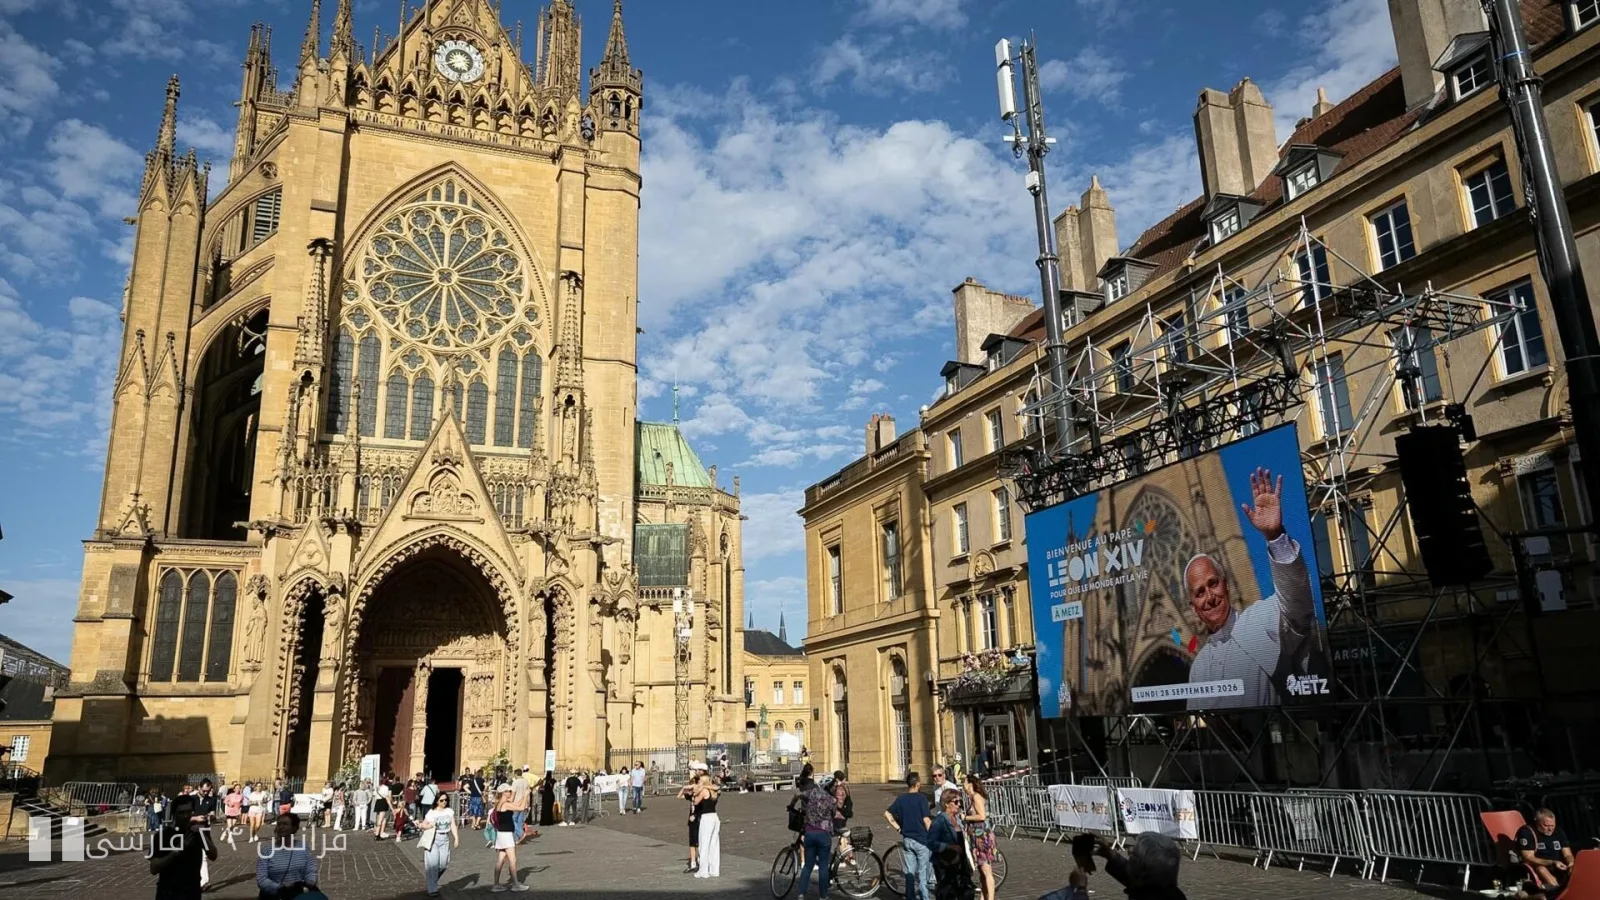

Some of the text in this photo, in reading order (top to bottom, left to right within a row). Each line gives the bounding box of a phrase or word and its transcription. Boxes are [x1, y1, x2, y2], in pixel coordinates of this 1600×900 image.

[1046, 528, 1132, 560] BIENVENUE AU PAPE
[1047, 539, 1144, 587] LEON XIV
[1050, 570, 1148, 599] POUR QUE LE MONDE AIT LA VIE
[1054, 605, 1080, 618] À METZ
[1136, 684, 1238, 699] LUNDI 28 SEPTEMBRE 2026
[1289, 678, 1330, 696] METZ
[1137, 803, 1156, 812] LEON
